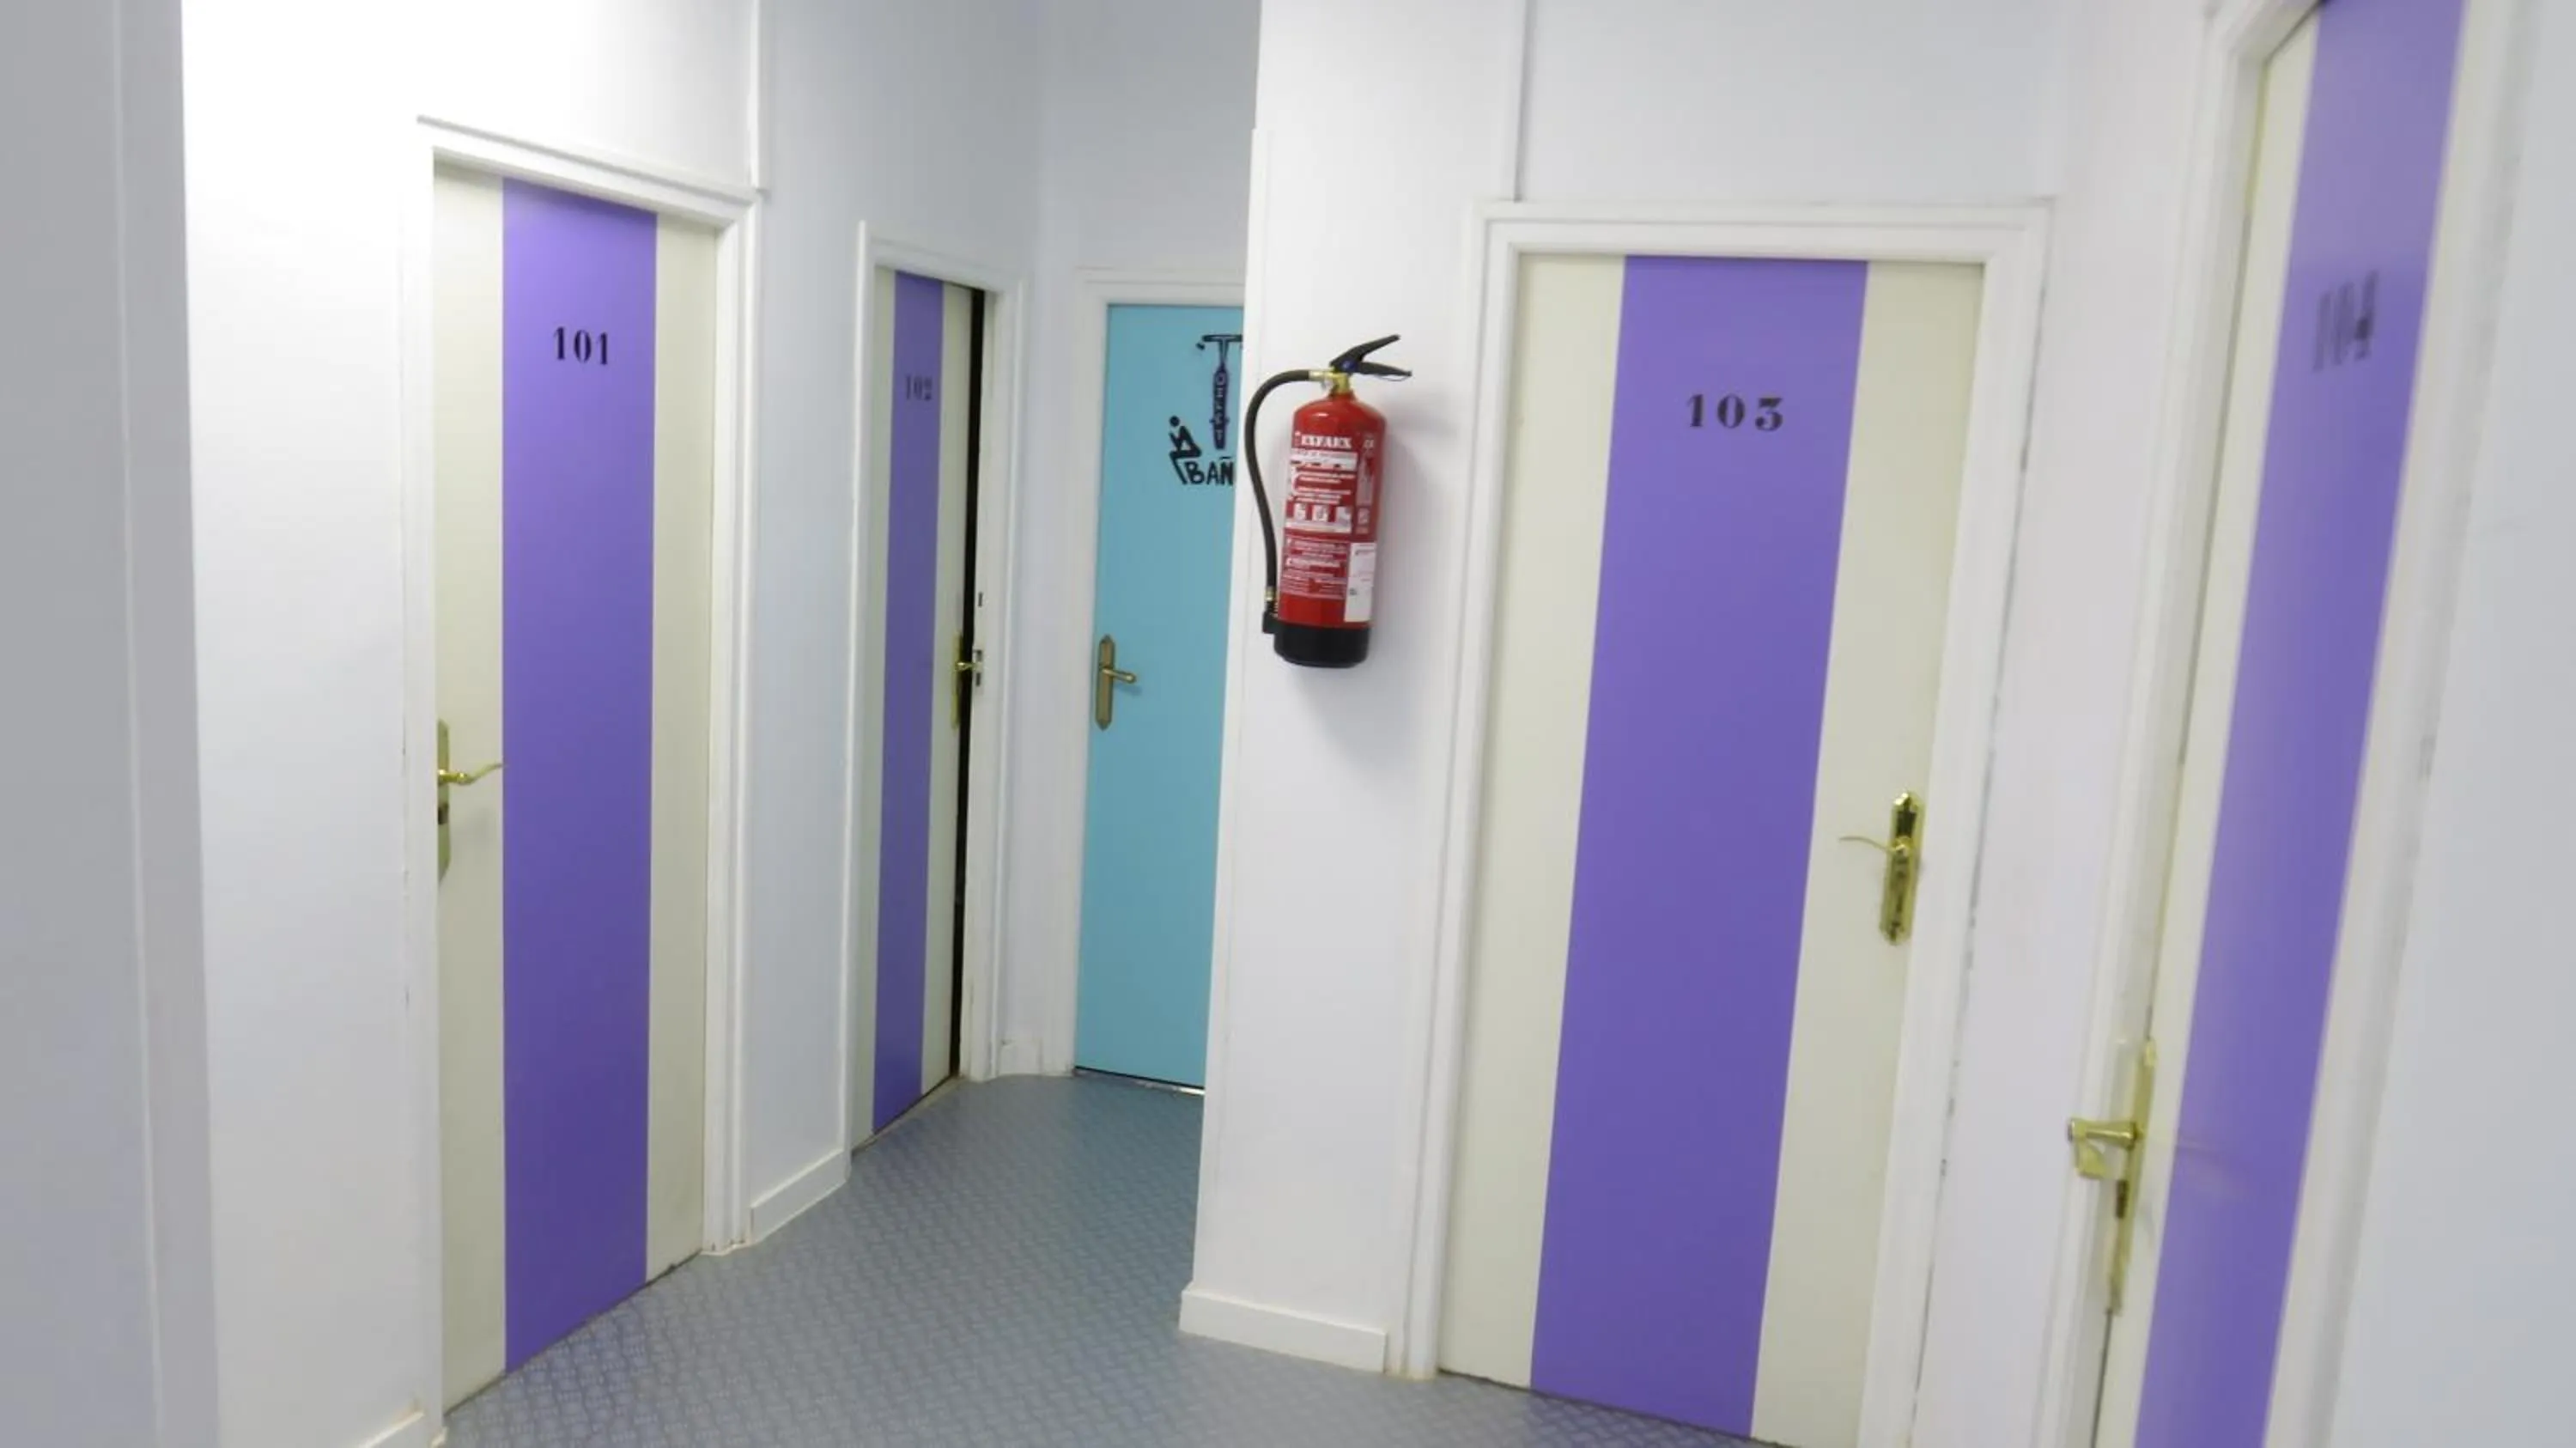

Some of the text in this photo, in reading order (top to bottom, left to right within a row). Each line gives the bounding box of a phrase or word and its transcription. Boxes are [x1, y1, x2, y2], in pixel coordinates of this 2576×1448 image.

[554, 326, 608, 366] 101
[904, 374, 933, 402] 102
[1686, 393, 1783, 432] 103
[1184, 456, 1234, 486] BAÑ
